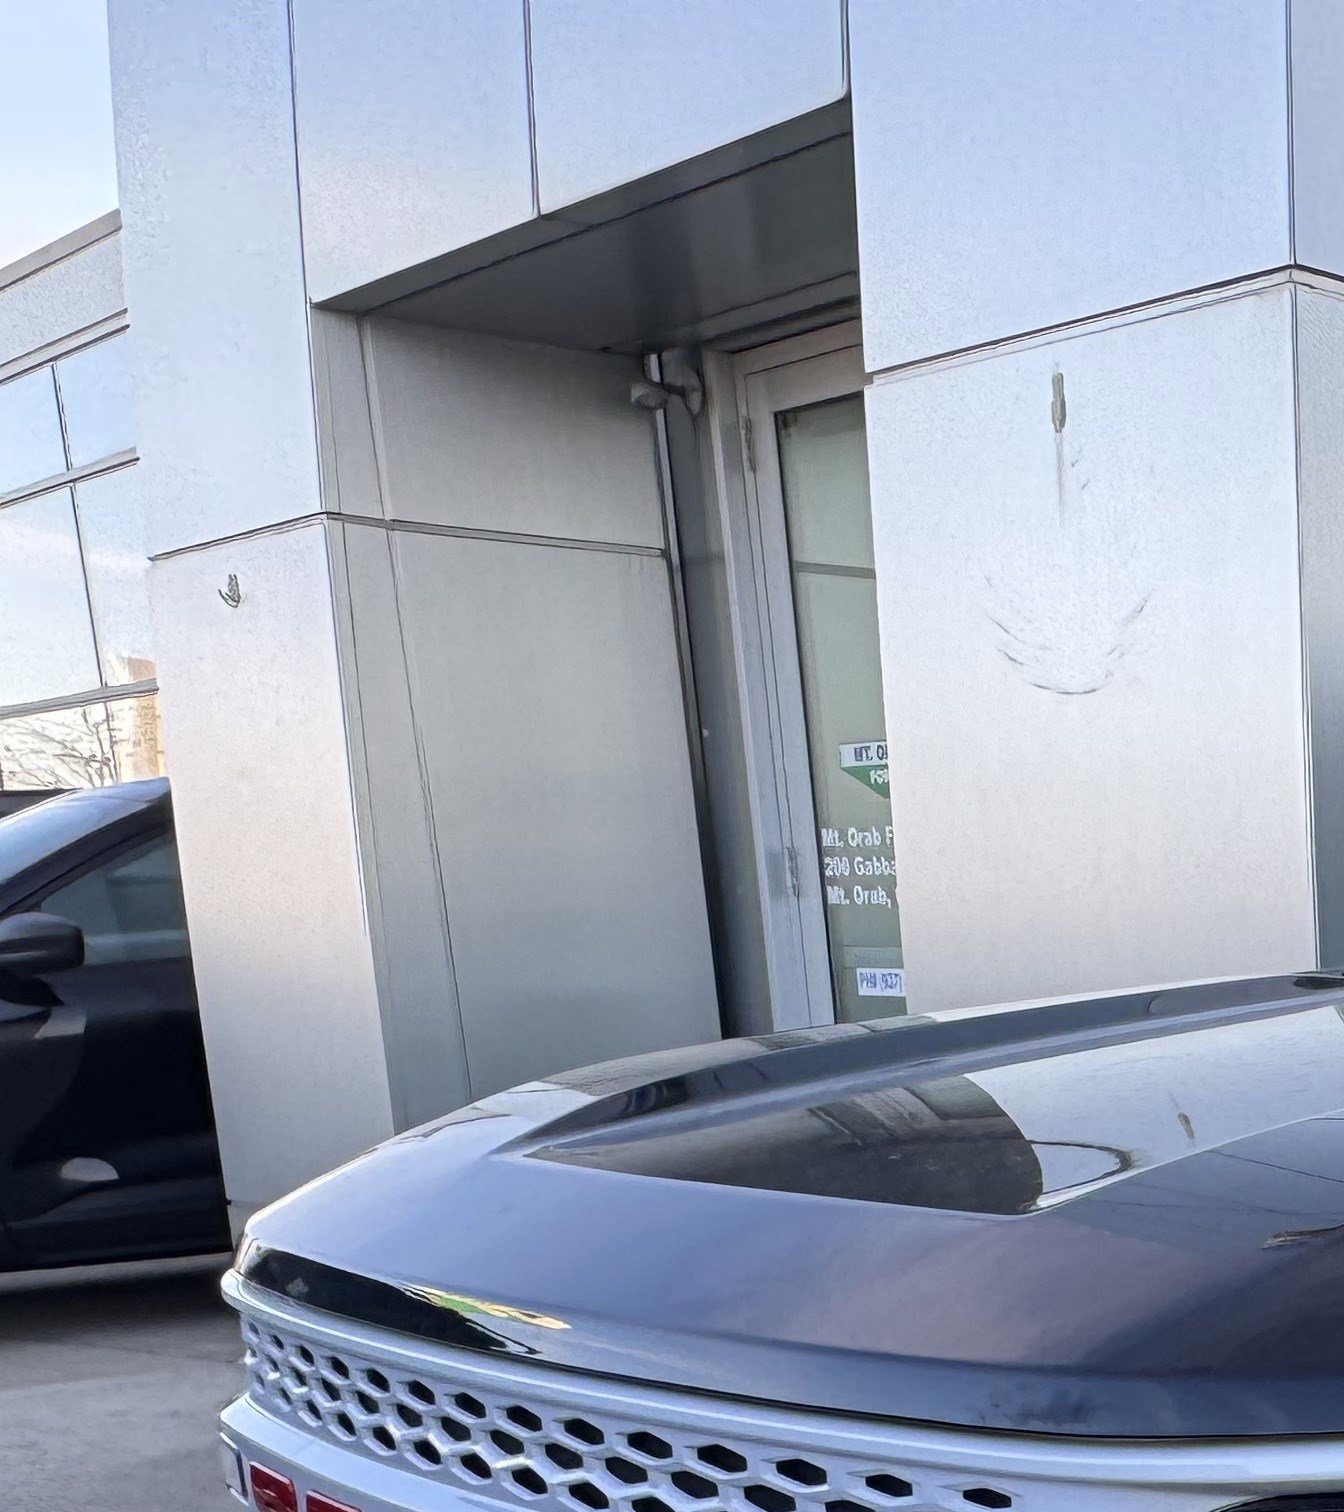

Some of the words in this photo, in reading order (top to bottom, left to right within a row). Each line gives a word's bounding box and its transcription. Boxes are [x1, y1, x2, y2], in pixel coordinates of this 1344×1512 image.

[821, 828, 844, 848] Mt.
[848, 826, 882, 848] Orab
[823, 857, 851, 879] 200
[827, 886, 850, 905] Mt.
[853, 885, 892, 909] Orab,
